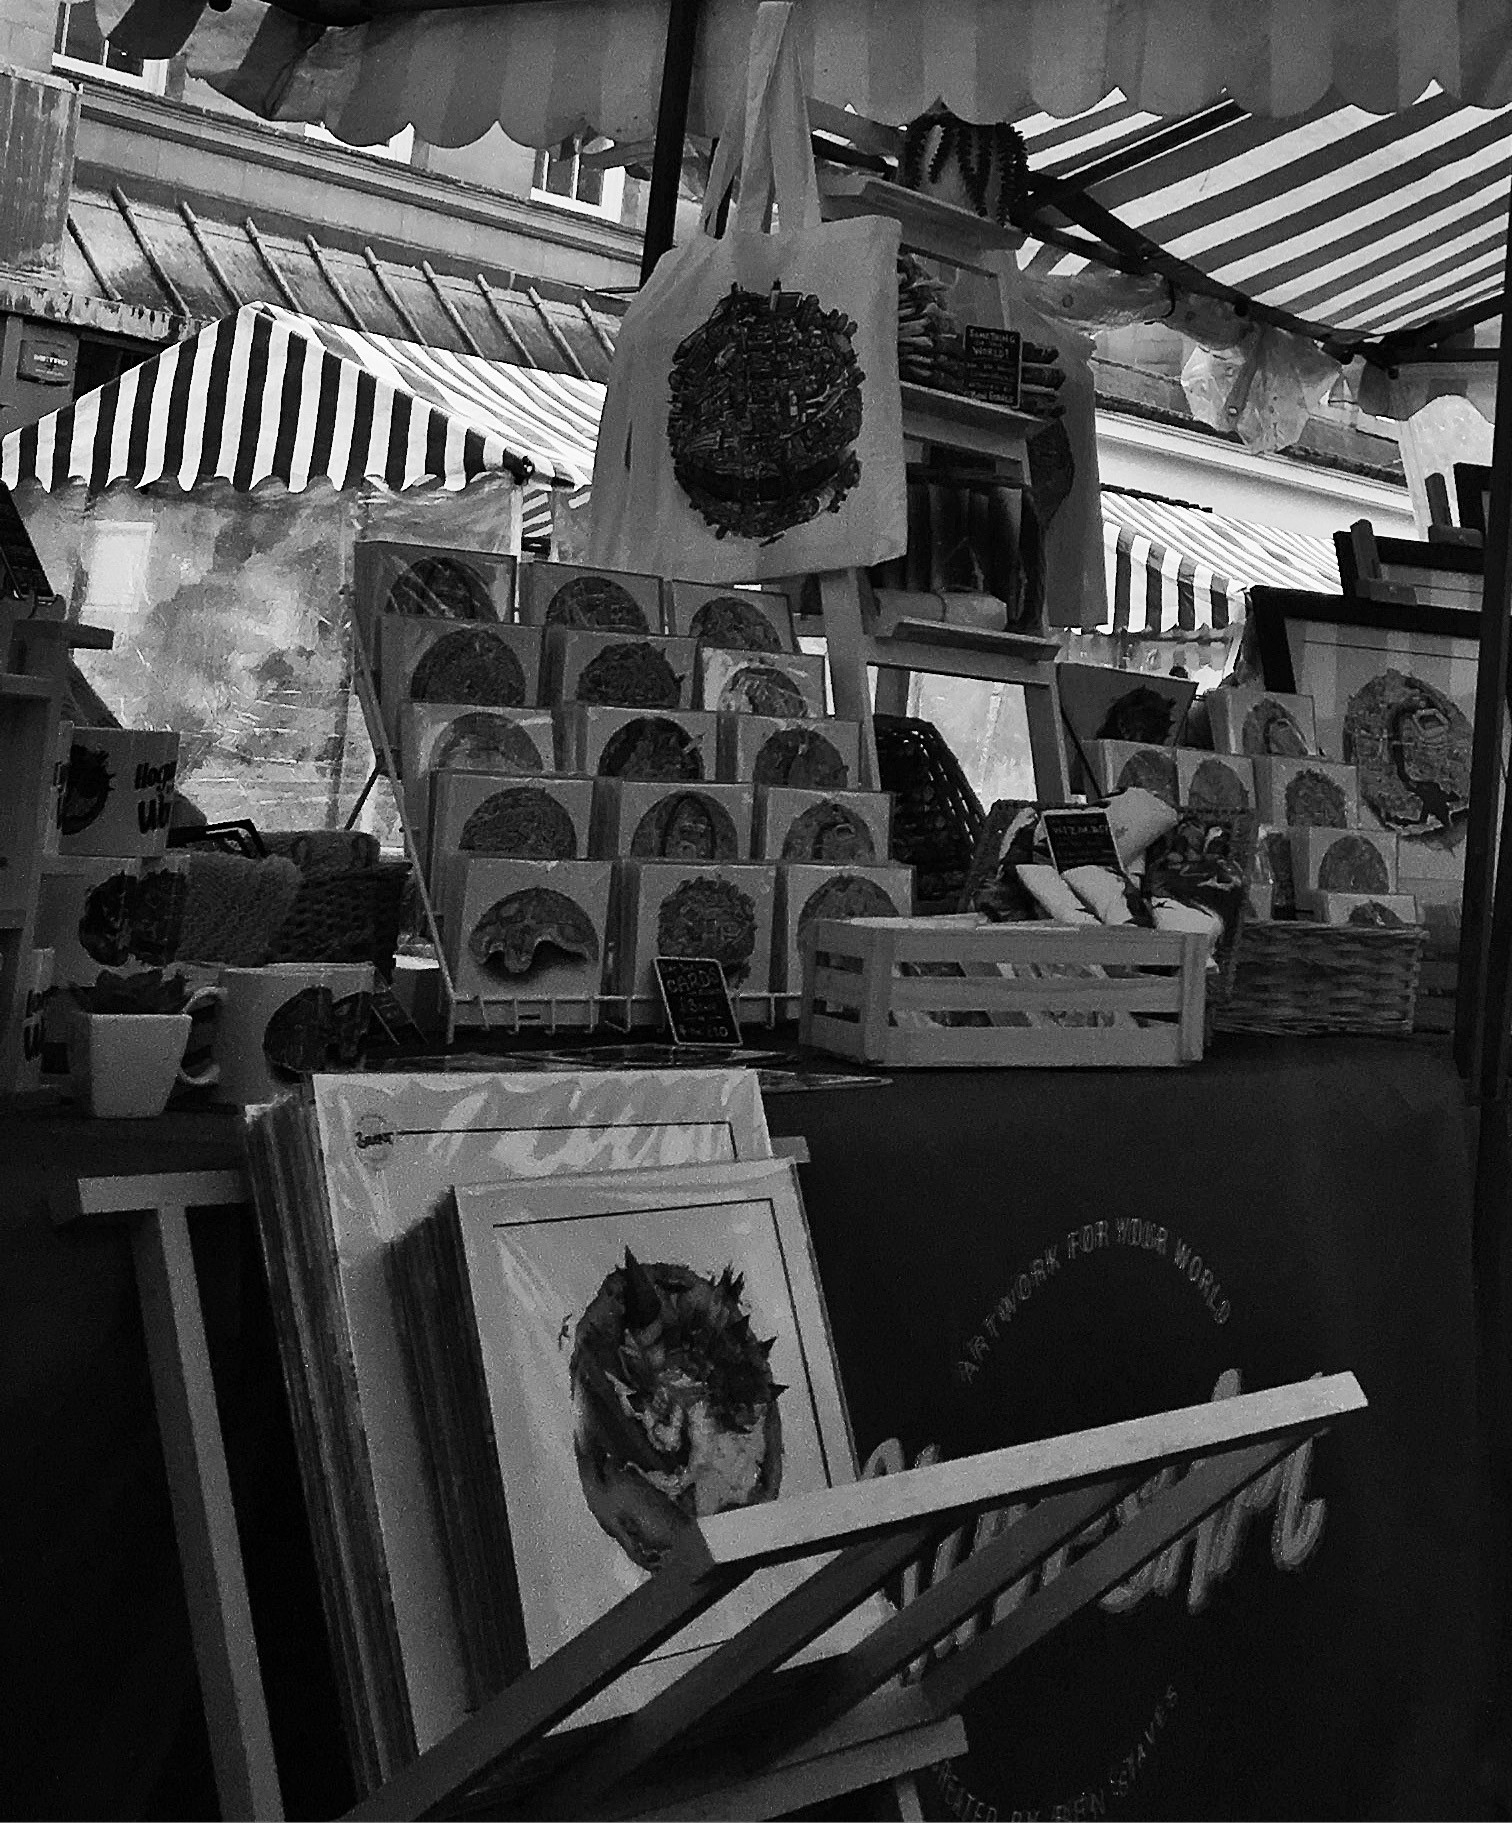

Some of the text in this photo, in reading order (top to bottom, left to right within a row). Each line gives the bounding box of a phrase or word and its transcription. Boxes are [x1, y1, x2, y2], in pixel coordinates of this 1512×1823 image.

[1066, 1219, 1110, 1260] FOR
[1115, 1217, 1168, 1256] YOUR
[1174, 1238, 1231, 1325] WORLD
